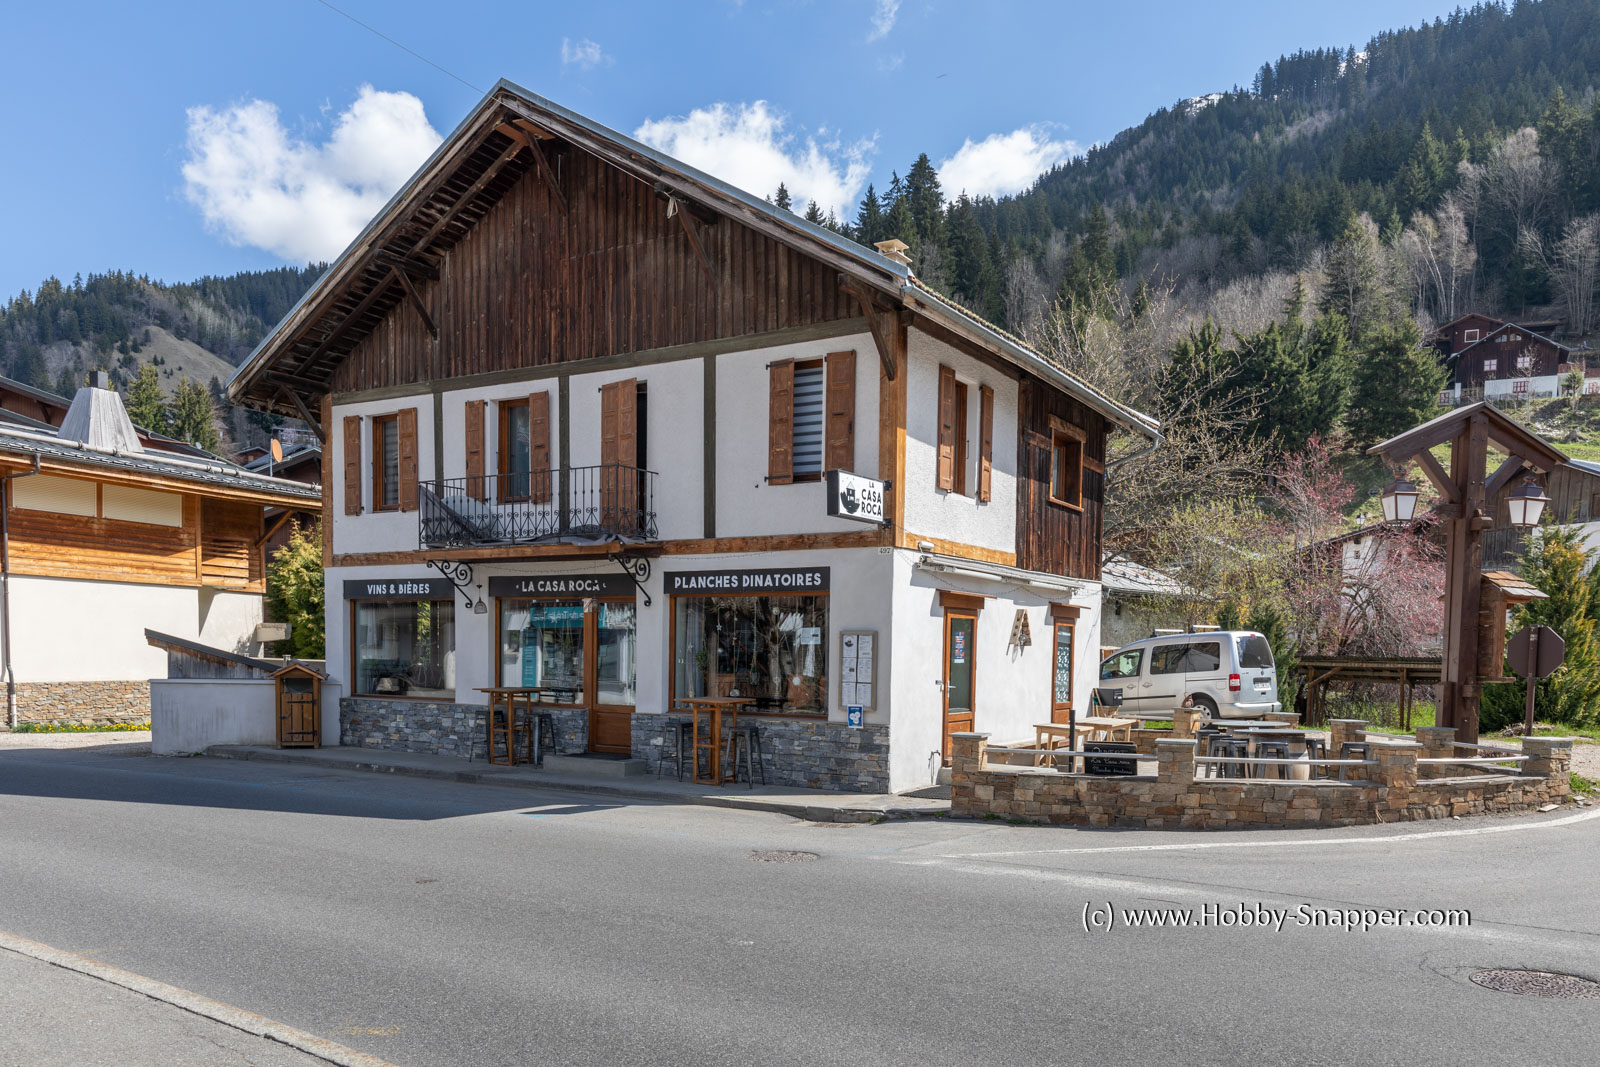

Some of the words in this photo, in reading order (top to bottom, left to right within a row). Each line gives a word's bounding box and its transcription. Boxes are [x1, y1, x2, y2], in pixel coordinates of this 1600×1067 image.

[868, 481, 875, 489] LA
[861, 489, 882, 504] CASA
[861, 501, 882, 516] ROCA
[521, 580, 535, 592] LA
[537, 580, 566, 592] CASA
[674, 575, 739, 589] PLANCHES
[742, 572, 822, 587] DINATOIRES
[367, 584, 387, 595] VINS
[389, 584, 396, 594] &
[398, 581, 430, 594] BIÈRES
